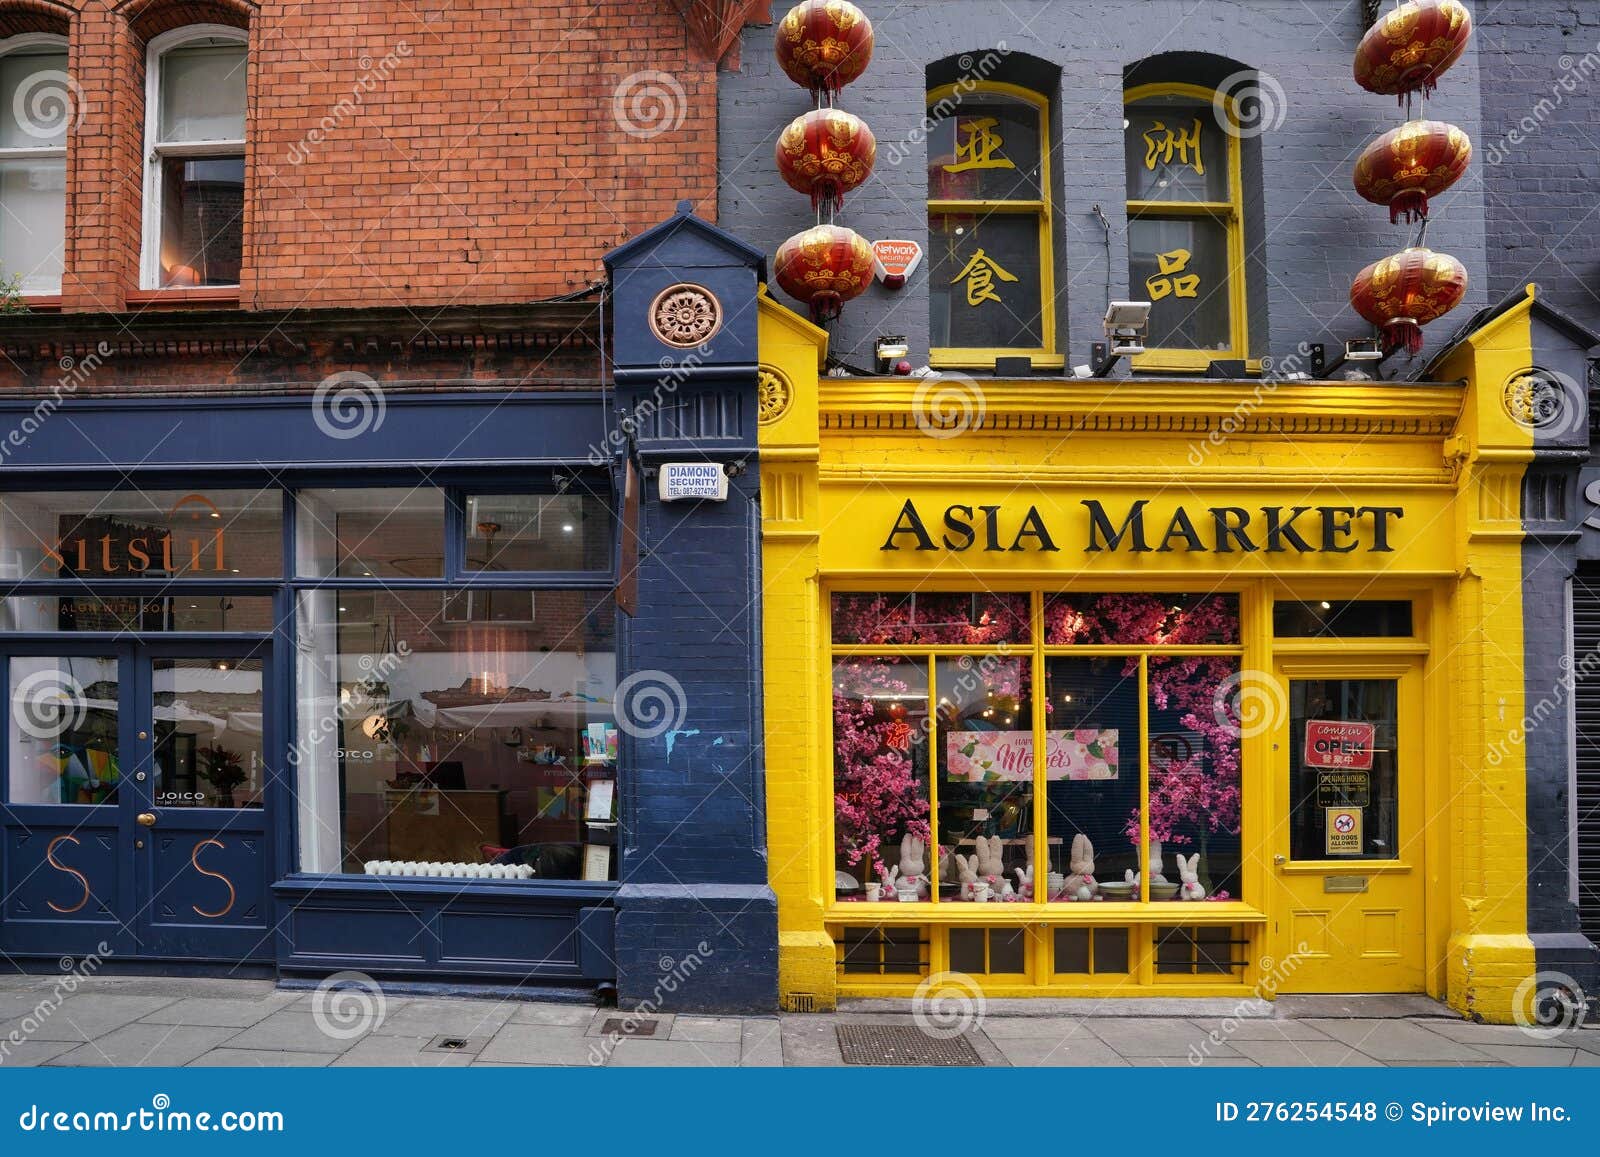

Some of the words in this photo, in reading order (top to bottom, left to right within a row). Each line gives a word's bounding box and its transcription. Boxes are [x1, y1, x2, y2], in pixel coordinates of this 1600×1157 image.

[876, 245, 916, 255] Network
[950, 248, 1020, 306] 食
[1146, 249, 1201, 301] 品
[670, 467, 717, 477] DIAMOND
[670, 478, 717, 486] SECURITY
[880, 498, 1061, 553] ASIA
[1080, 499, 1404, 553] MARKET
[1314, 739, 1364, 755] OPEN
[1346, 774, 1366, 783] HOURS
[156, 792, 205, 800] JOICO
[47, 834, 90, 913] S
[191, 839, 236, 918] S
